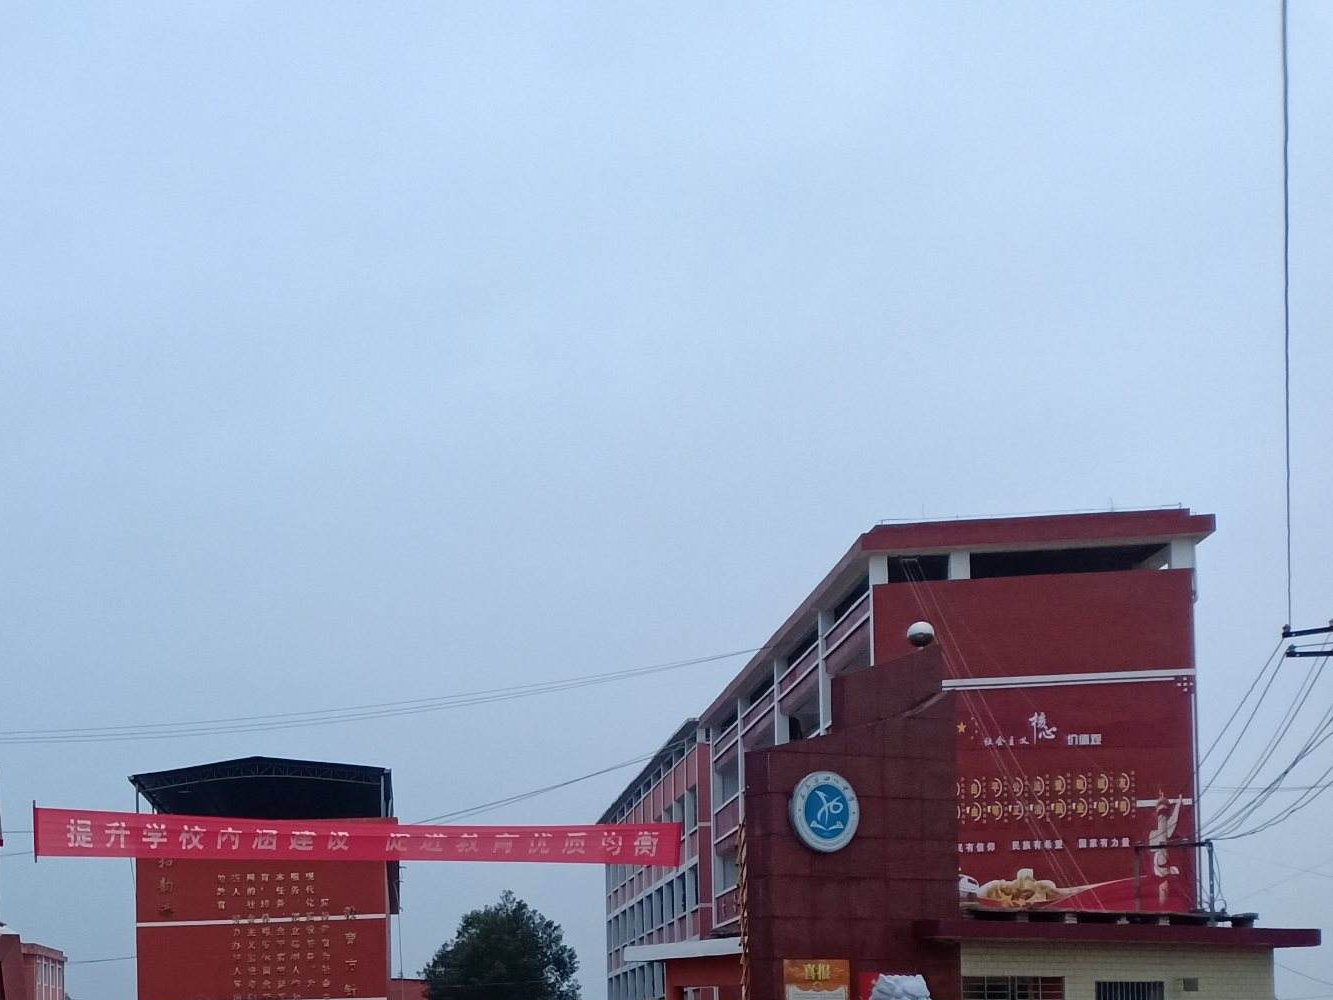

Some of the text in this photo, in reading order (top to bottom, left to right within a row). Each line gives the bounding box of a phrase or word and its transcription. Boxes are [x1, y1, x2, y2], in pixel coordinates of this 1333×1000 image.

[66, 819, 350, 851] 提升学校内涵建设
